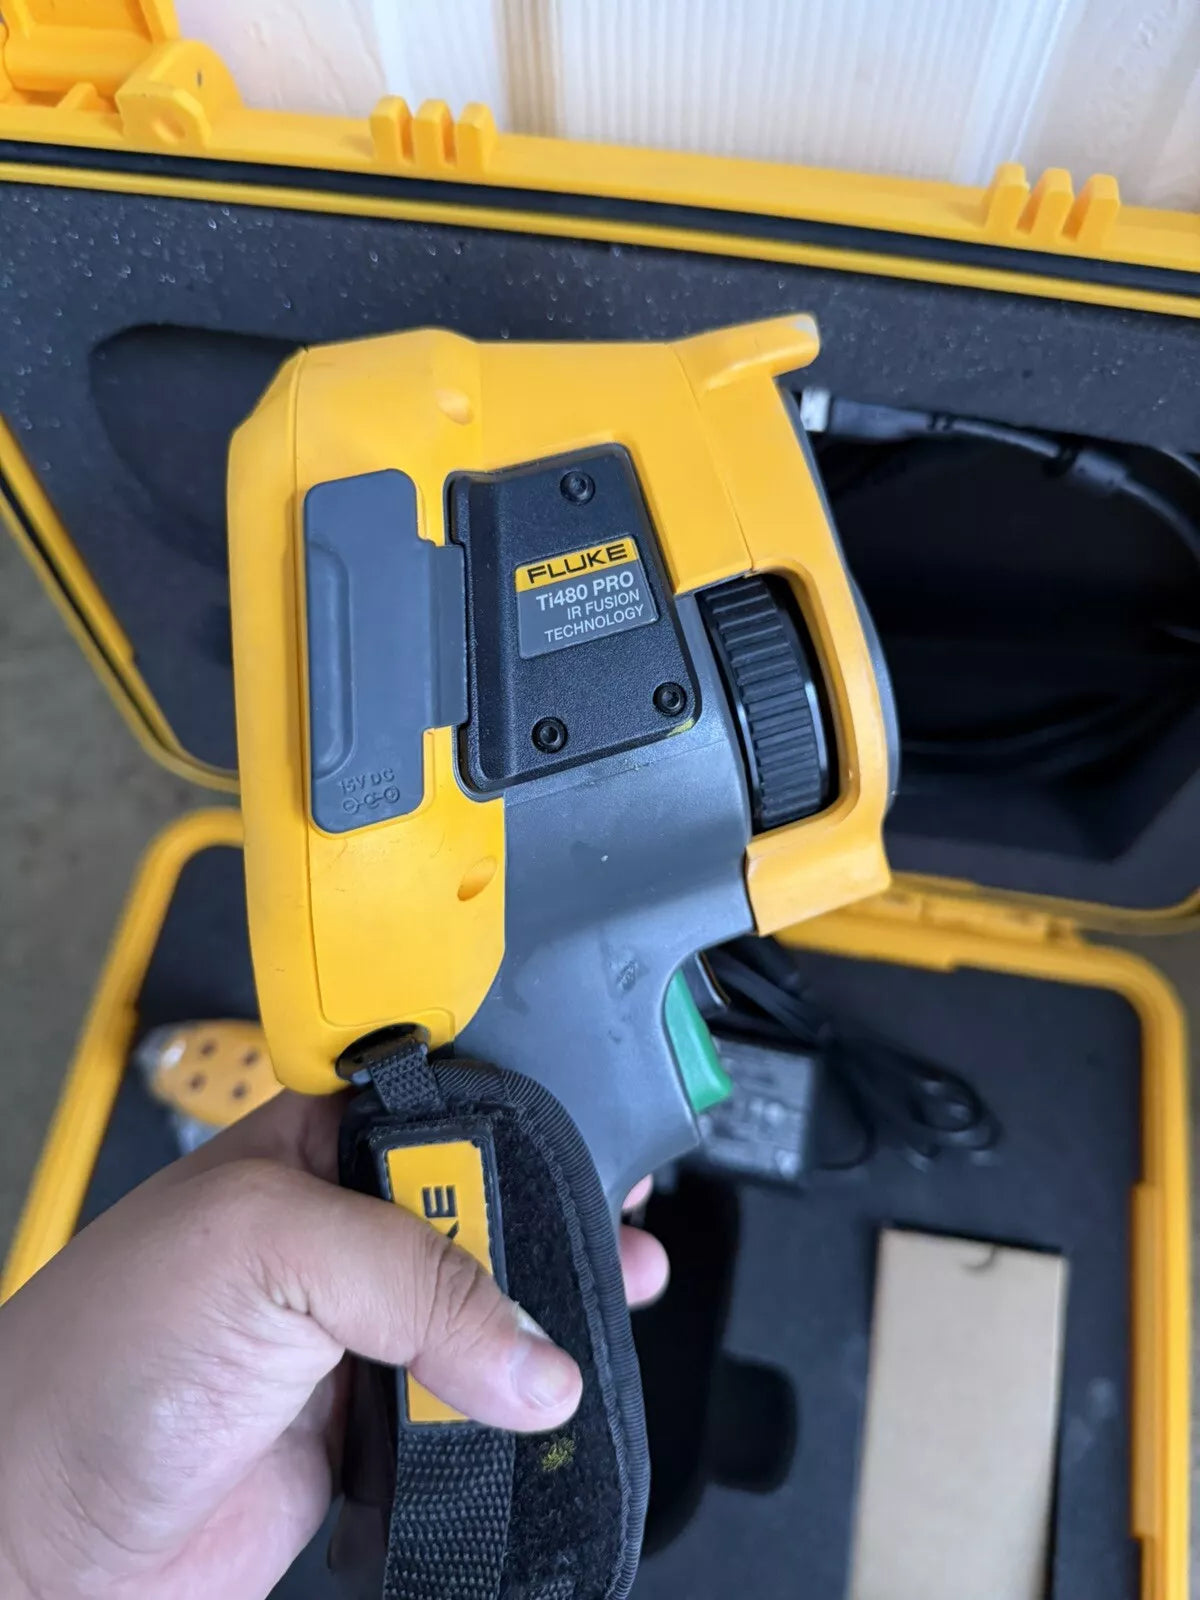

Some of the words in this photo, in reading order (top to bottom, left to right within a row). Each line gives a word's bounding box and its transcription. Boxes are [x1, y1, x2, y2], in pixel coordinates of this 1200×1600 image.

[527, 543, 628, 584] FLUKE
[535, 584, 588, 612] Ti480
[592, 571, 634, 597] PRO
[567, 606, 582, 620] IR
[585, 588, 640, 615] FUSION
[544, 603, 644, 643] TECHNOLOGY
[340, 774, 366, 795] 15V
[370, 767, 395, 786] DC
